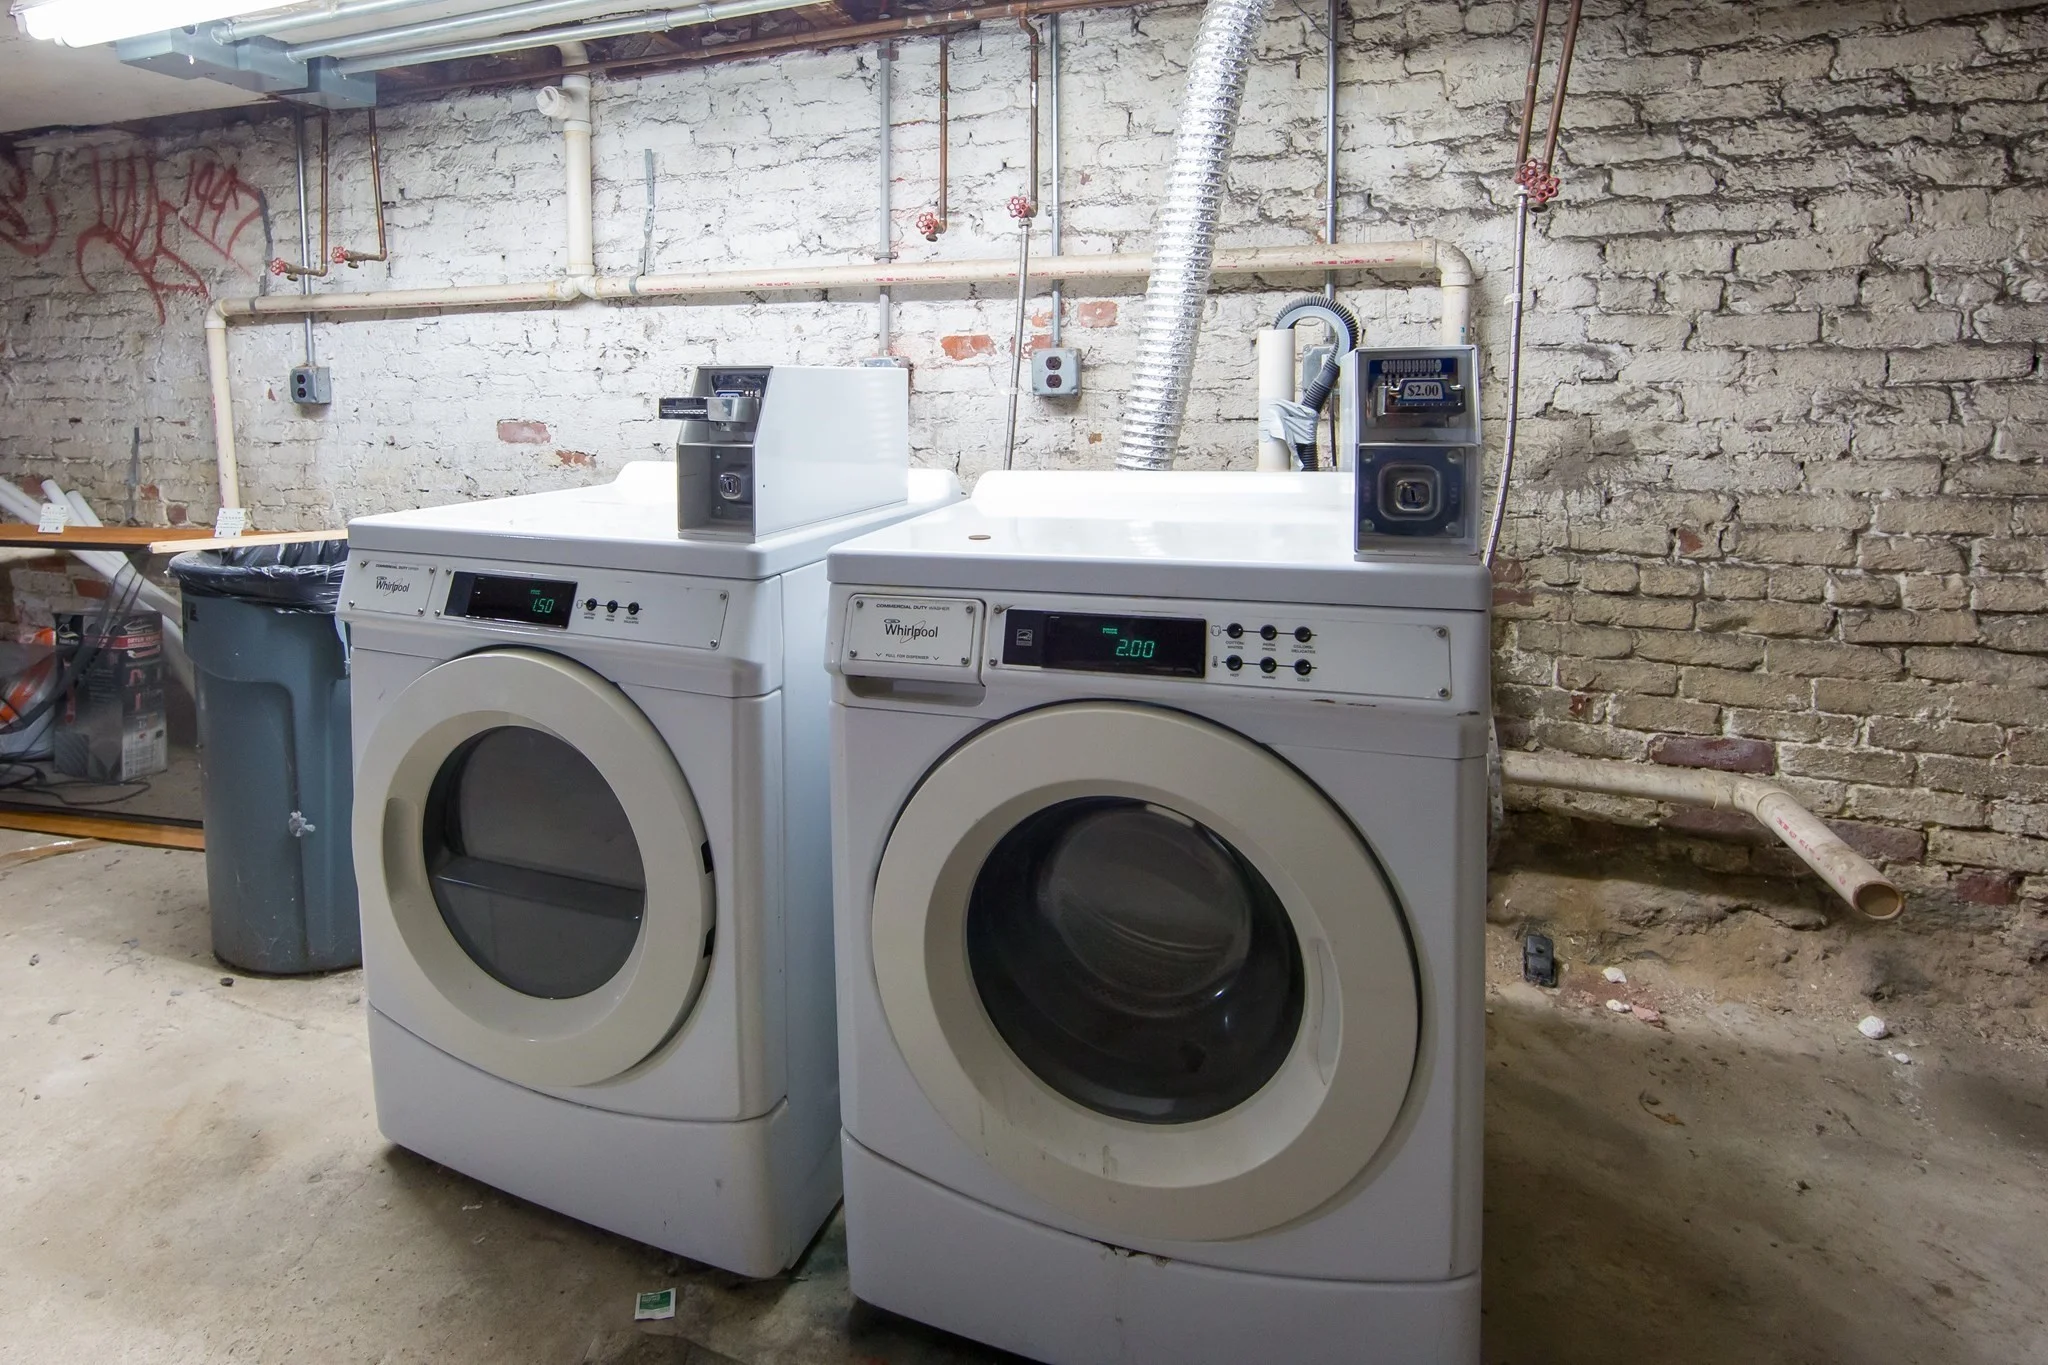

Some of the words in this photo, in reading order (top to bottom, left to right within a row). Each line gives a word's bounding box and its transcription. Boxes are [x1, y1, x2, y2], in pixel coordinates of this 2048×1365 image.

[1407, 384, 1439, 397] $2.00
[376, 579, 411, 594] Whirlpool
[884, 623, 939, 641] Whirlpool
[1115, 639, 1155, 658] 2.00
